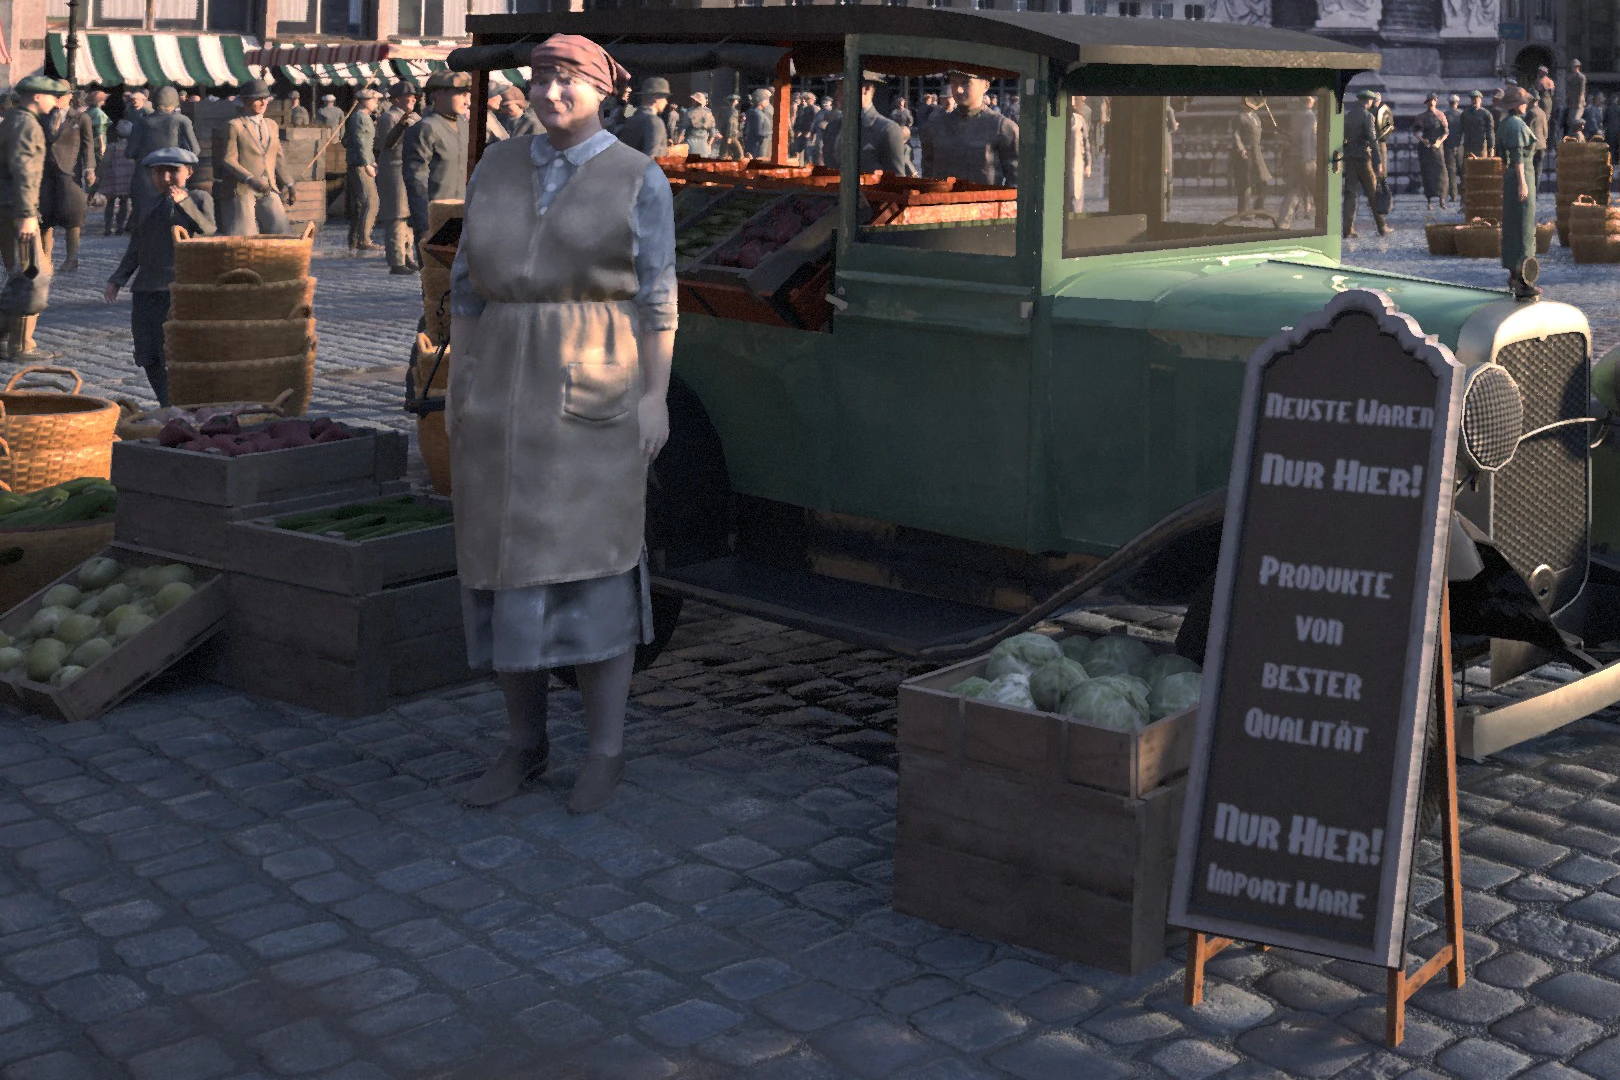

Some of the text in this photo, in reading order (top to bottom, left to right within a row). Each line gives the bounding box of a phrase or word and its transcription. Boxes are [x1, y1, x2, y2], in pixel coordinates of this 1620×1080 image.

[1260, 453, 1423, 498] NUR HIER!
[1259, 555, 1393, 599] PRODUKTE
[1261, 662, 1363, 700] BESTER
[1244, 707, 1369, 753] QUALITÄT
[1214, 802, 1383, 865] NUR HIER!
[1207, 863, 1365, 919] IMPORT WARE
